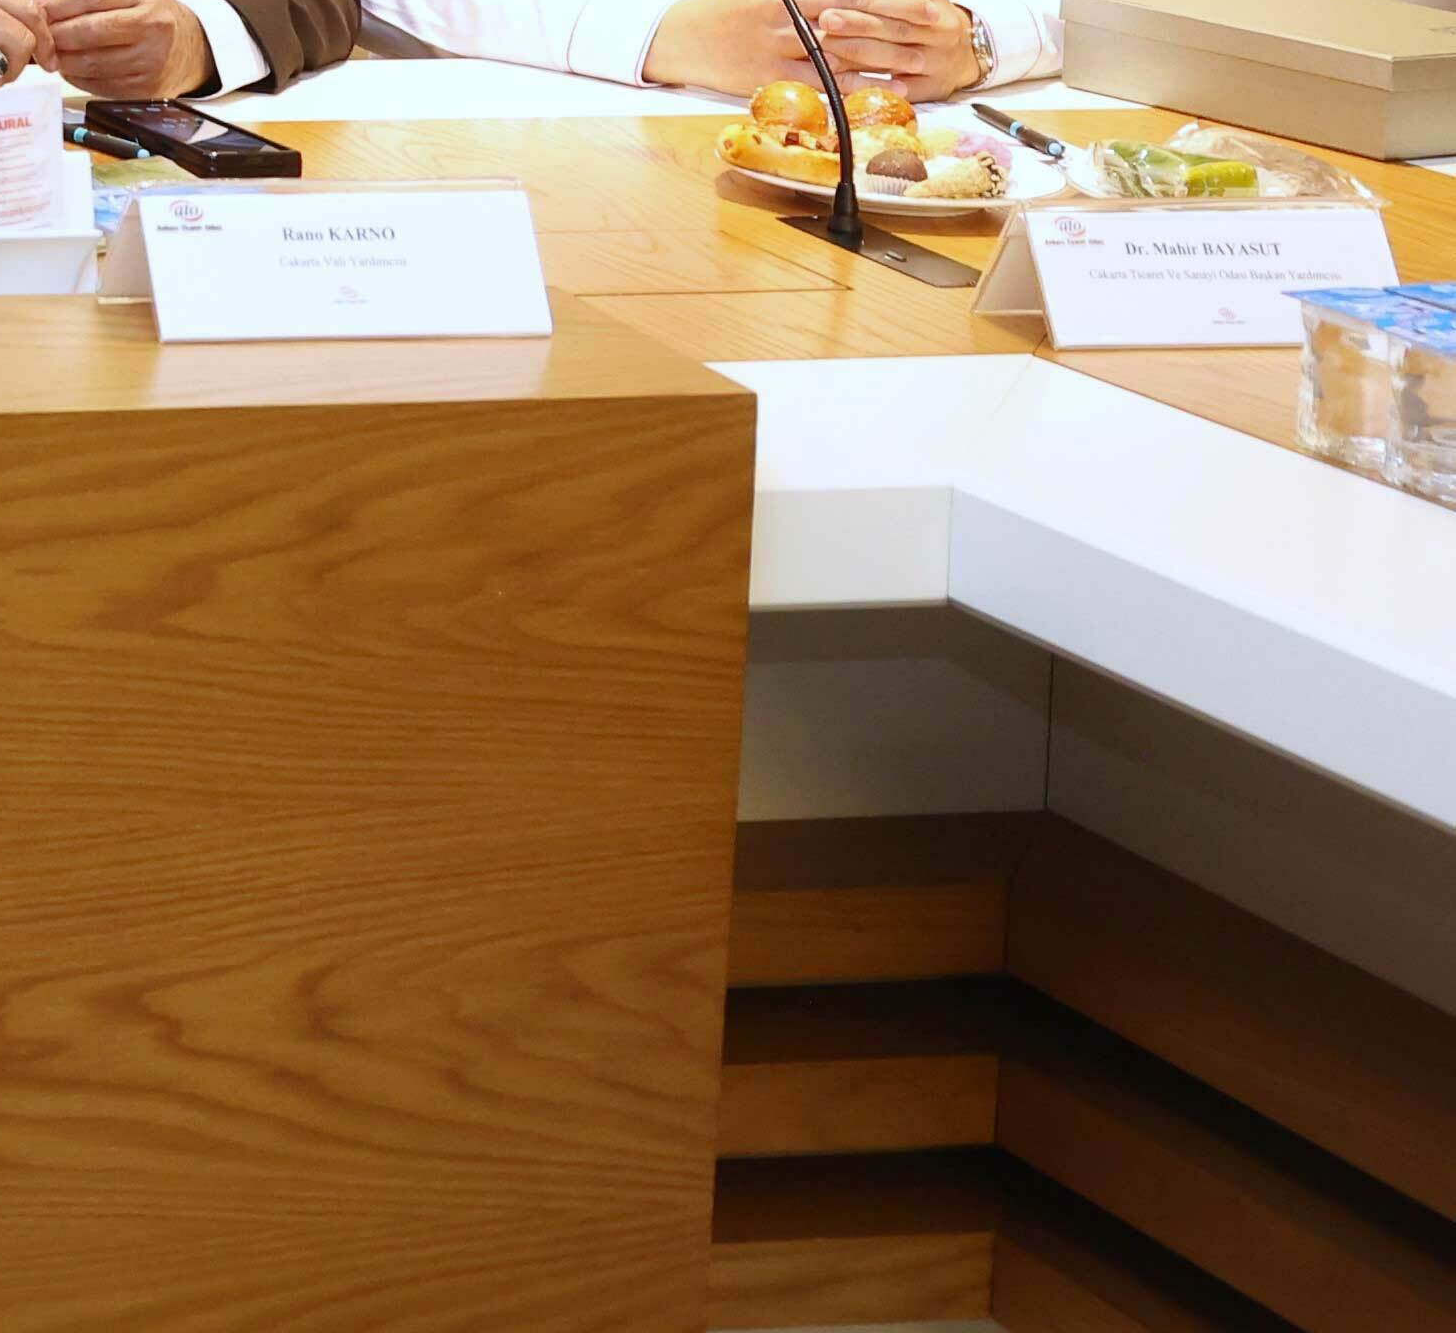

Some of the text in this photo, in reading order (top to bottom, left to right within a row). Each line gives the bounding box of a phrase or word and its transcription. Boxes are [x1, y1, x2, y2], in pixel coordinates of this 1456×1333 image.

[281, 226, 397, 242] Rano KARNO
[1124, 241, 1282, 256] Dr. Mahir BAYASUT
